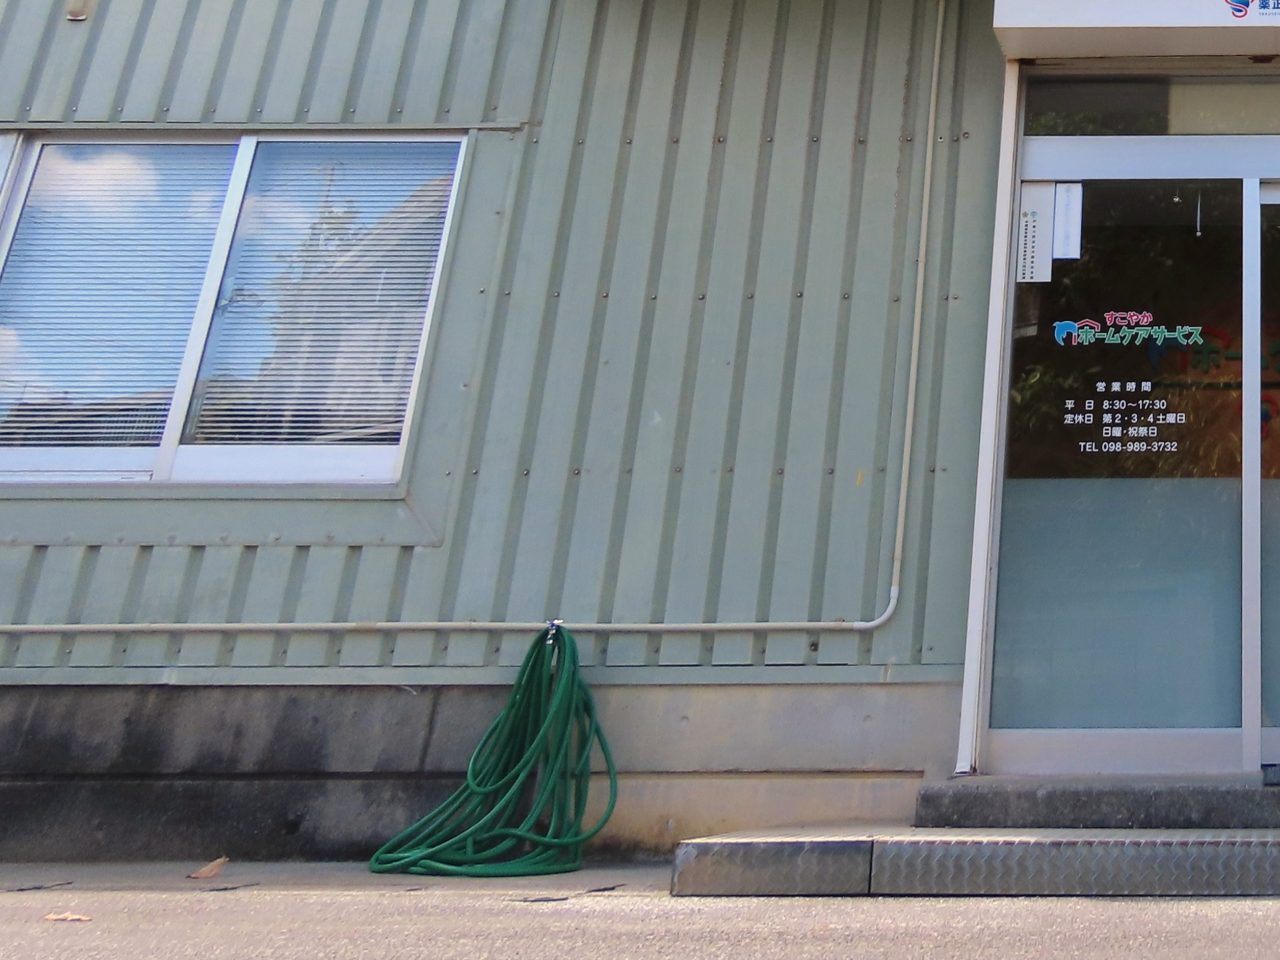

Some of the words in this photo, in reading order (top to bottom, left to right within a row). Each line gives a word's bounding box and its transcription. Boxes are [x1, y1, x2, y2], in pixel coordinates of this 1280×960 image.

[1104, 311, 1153, 325] すこやか
[1078, 326, 1204, 345] ホームケアサービス
[1064, 414, 1094, 424] 定休日
[1079, 442, 1099, 452] TEL
[1102, 442, 1178, 452] 098-989-3732
